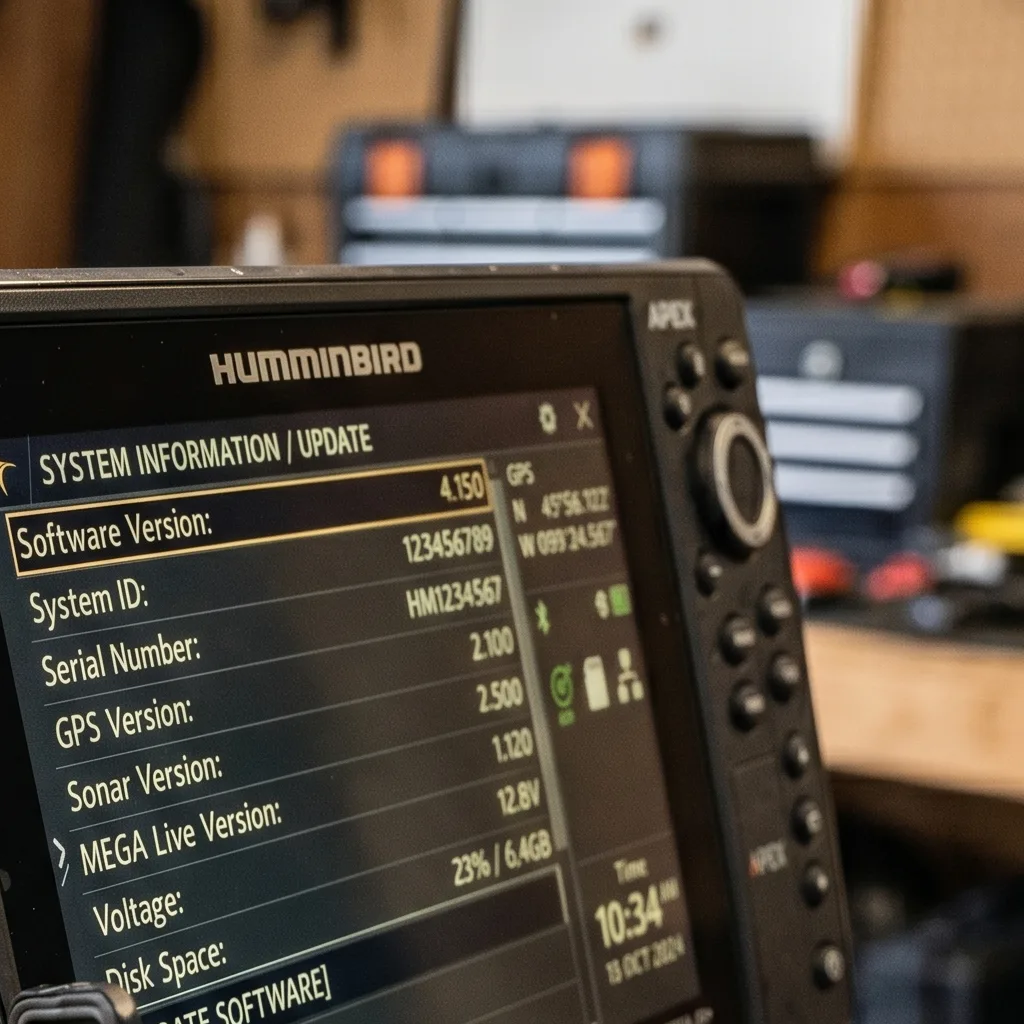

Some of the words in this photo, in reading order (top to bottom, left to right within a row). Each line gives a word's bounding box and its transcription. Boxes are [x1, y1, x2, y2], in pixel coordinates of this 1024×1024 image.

[209, 341, 423, 385] HUMMINBIRD
[39, 447, 131, 485] SYSTEM
[136, 432, 280, 475] INFORMATION
[286, 429, 294, 466] /
[298, 424, 373, 459] UPDATE
[506, 461, 535, 487] GPS
[439, 471, 484, 501] 4.150
[512, 498, 527, 523] N
[17, 522, 121, 559] Software
[125, 508, 213, 544] Version:
[402, 524, 494, 563] 123456789
[517, 533, 535, 559] W
[30, 584, 113, 631] System
[117, 577, 149, 611] ID:
[406, 575, 502, 618] HM1234567
[42, 644, 106, 687] Serial
[110, 633, 201, 674] Number:
[470, 626, 515, 661] 2.100
[477, 677, 524, 713] 2.500
[55, 711, 101, 749] GPS
[105, 697, 194, 739] Version:
[492, 728, 533, 763] 1.120
[67, 775, 131, 813] Sonar
[136, 755, 223, 796] Version:
[497, 778, 540, 815] 12.8V
[80, 829, 149, 876] MEGA
[153, 820, 196, 857] Live
[200, 801, 282, 843] Version:
[452, 848, 491, 887] 23%
[504, 829, 552, 868] 6.4GB
[93, 890, 184, 936] Voltage:
[595, 884, 663, 949] 10:34
[105, 957, 155, 995] Disk
[158, 942, 227, 988] Space:
